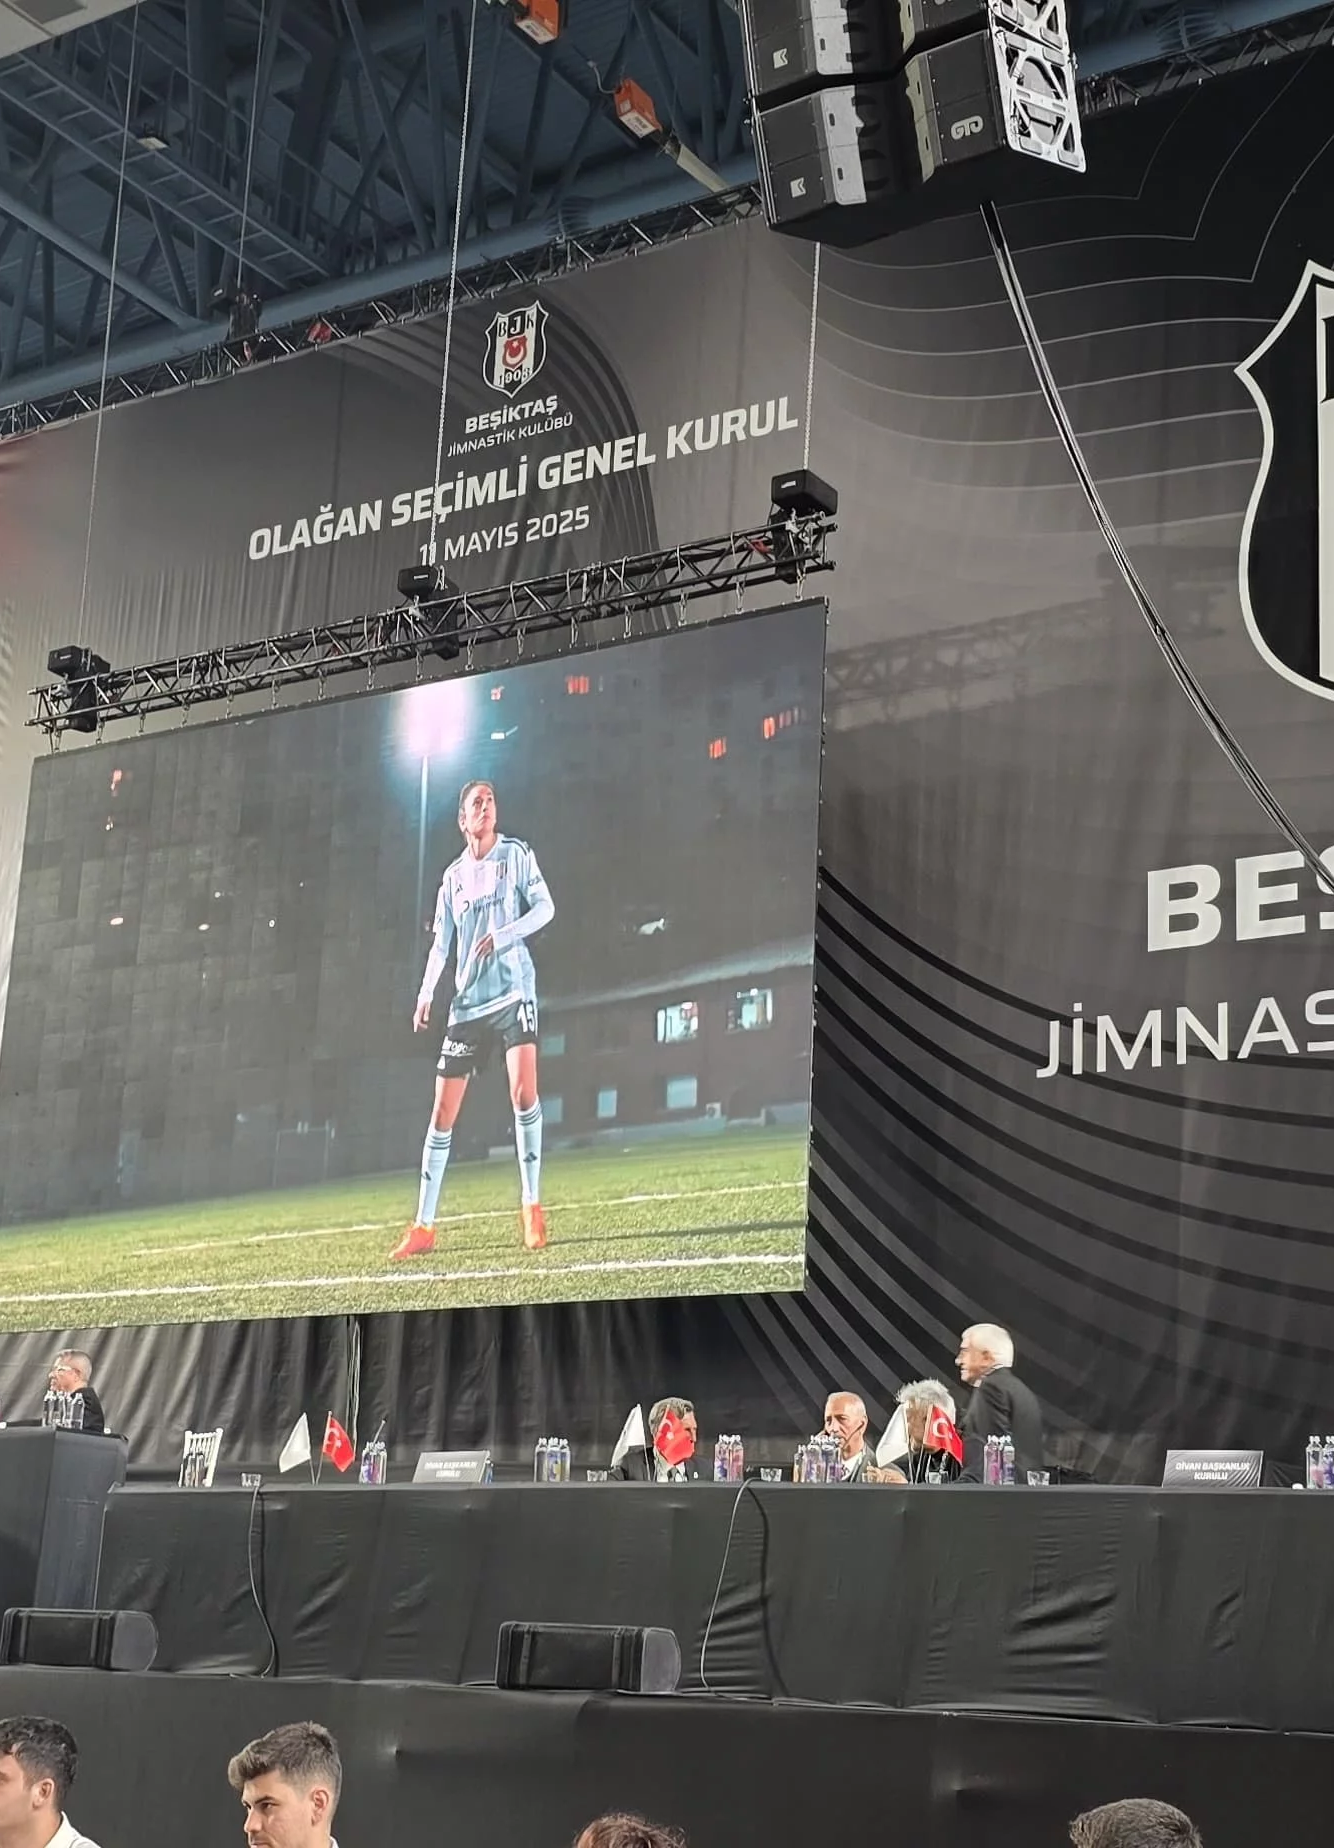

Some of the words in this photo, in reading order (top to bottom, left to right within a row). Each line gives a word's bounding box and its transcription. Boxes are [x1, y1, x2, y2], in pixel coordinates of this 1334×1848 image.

[446, 428, 516, 458] JİMNASTİK
[518, 411, 574, 440] KULÜBÜ
[464, 394, 559, 434] BEŞİKTAŞ
[248, 499, 383, 561] OLAĞAN
[391, 454, 529, 528] SEÇİMLİ
[537, 431, 657, 490] GENEL
[666, 396, 799, 460] KURUL
[443, 521, 519, 562] MAYIS
[525, 505, 590, 543] 2025
